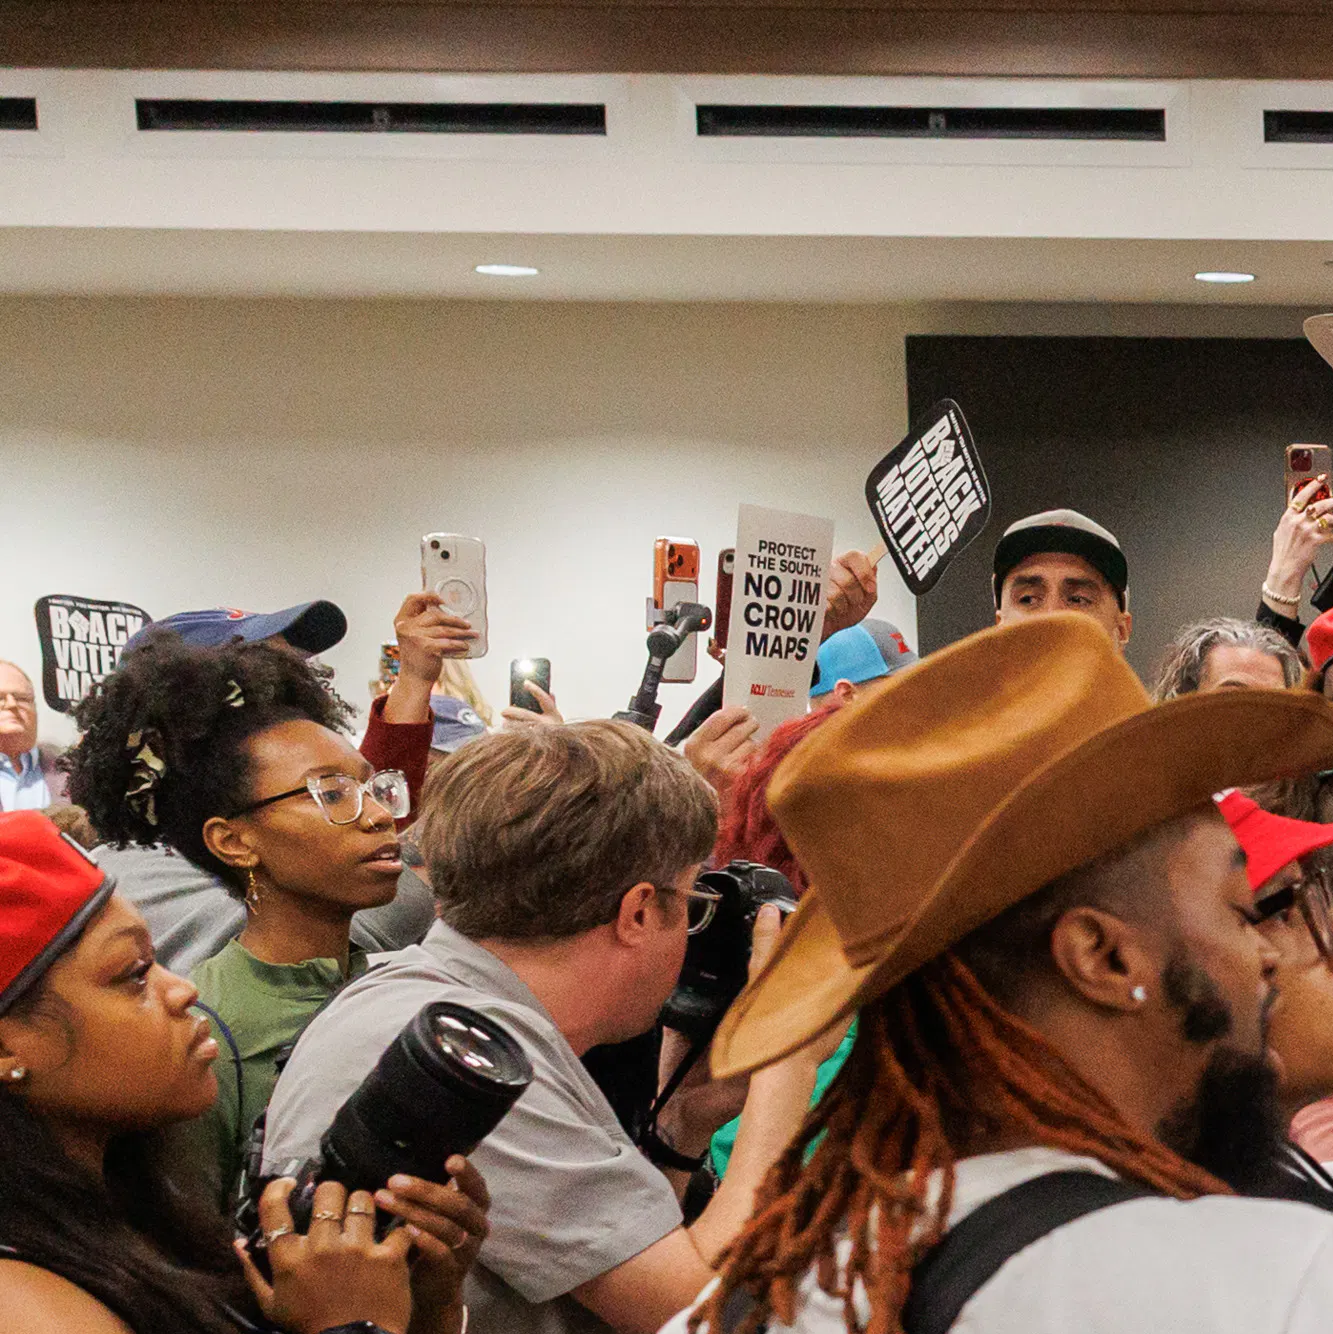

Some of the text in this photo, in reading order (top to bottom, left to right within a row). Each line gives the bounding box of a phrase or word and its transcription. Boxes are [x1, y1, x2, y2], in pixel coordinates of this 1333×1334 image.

[899, 439, 960, 557] VOTERS
[876, 464, 940, 582] MATTER
[748, 553, 822, 578] THE SOUTH:
[758, 539, 816, 561] PROTECT
[744, 572, 821, 606] NO JIM
[743, 602, 816, 634] CROW
[52, 639, 123, 675] VOTE
[745, 631, 810, 662] MAPS
